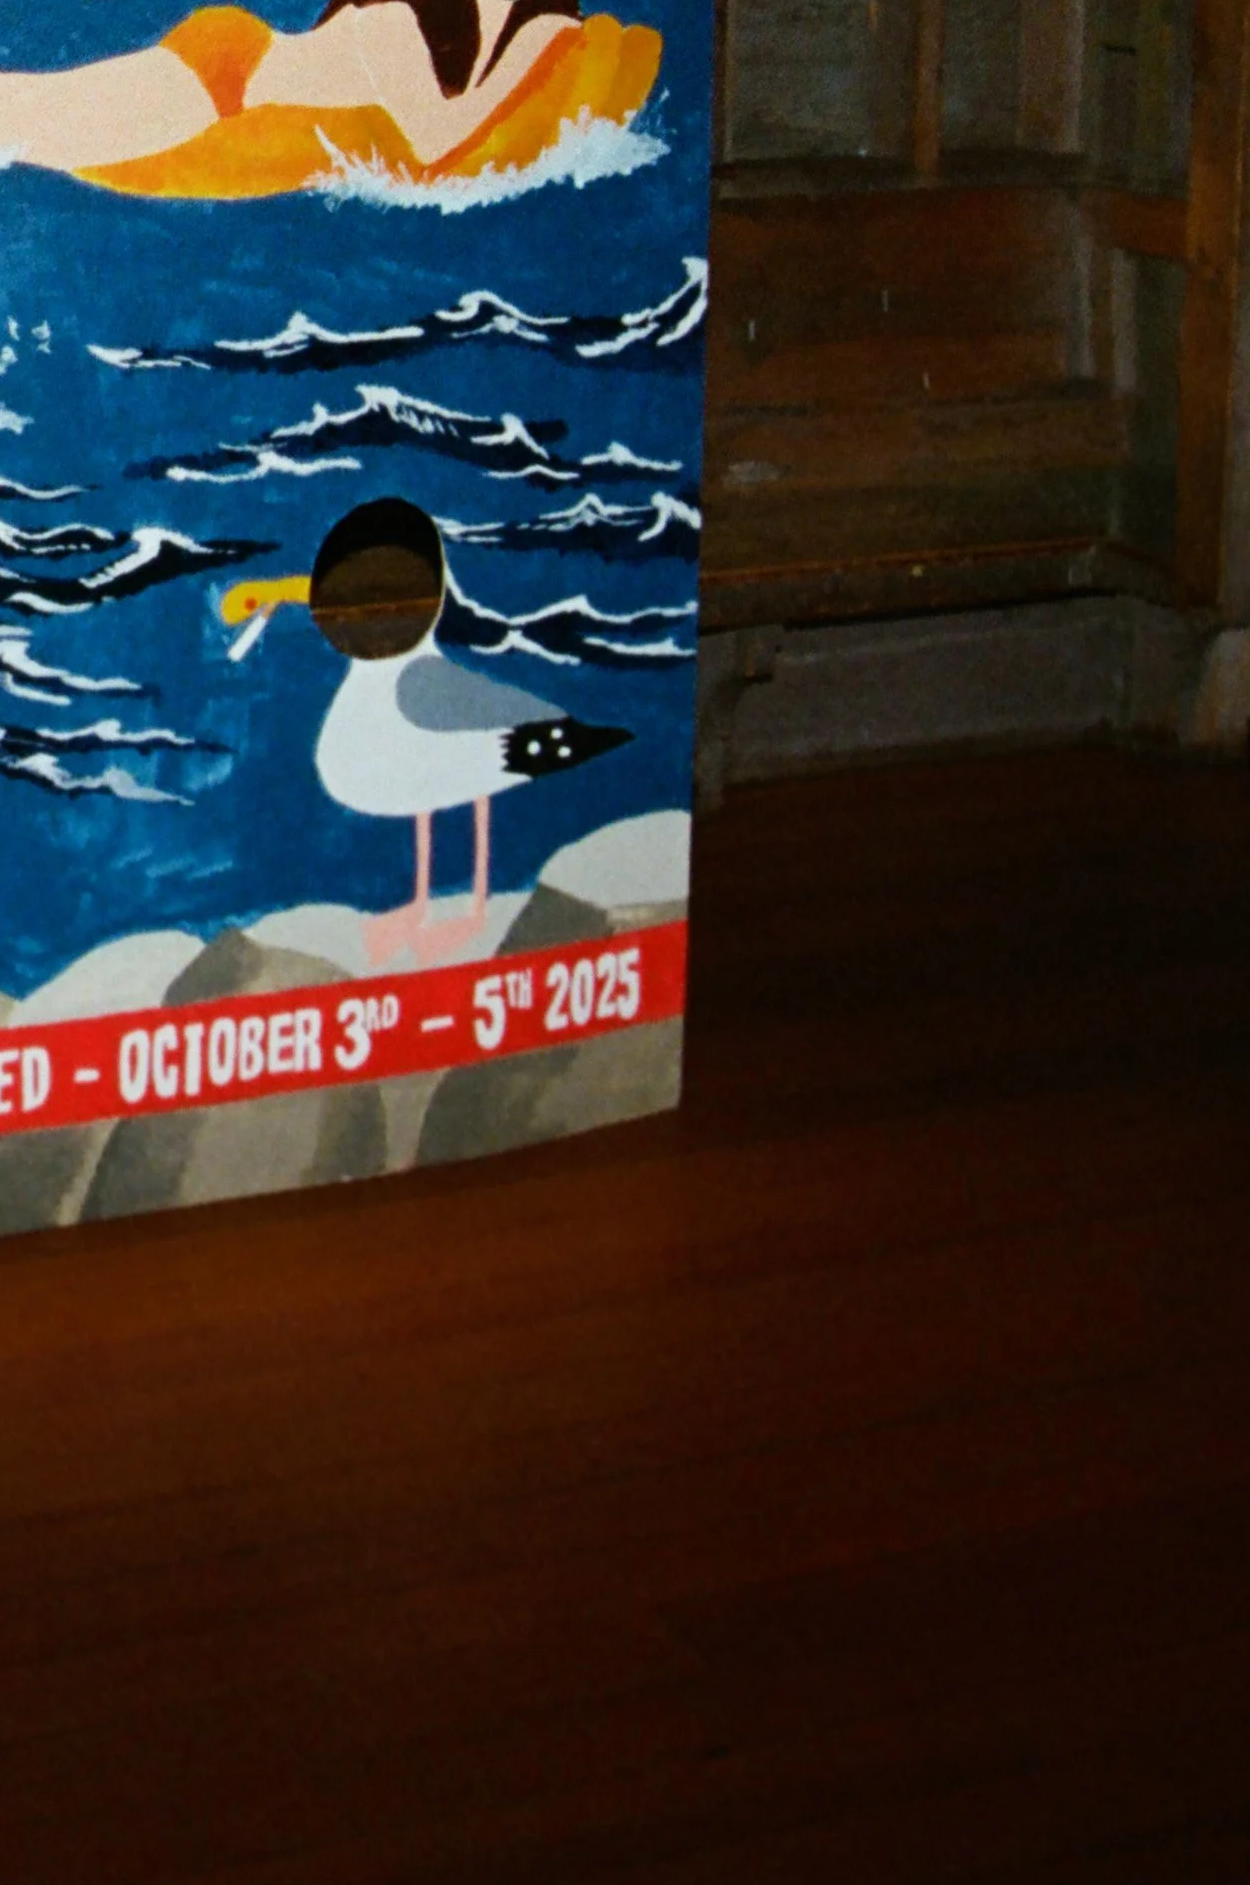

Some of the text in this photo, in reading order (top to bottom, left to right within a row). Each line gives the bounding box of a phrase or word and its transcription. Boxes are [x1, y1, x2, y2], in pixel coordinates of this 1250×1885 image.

[118, 1007, 322, 1104] OCTOBER
[334, 993, 400, 1071] 3RD
[473, 967, 533, 1050] 5TH
[545, 946, 642, 1032] 2025
